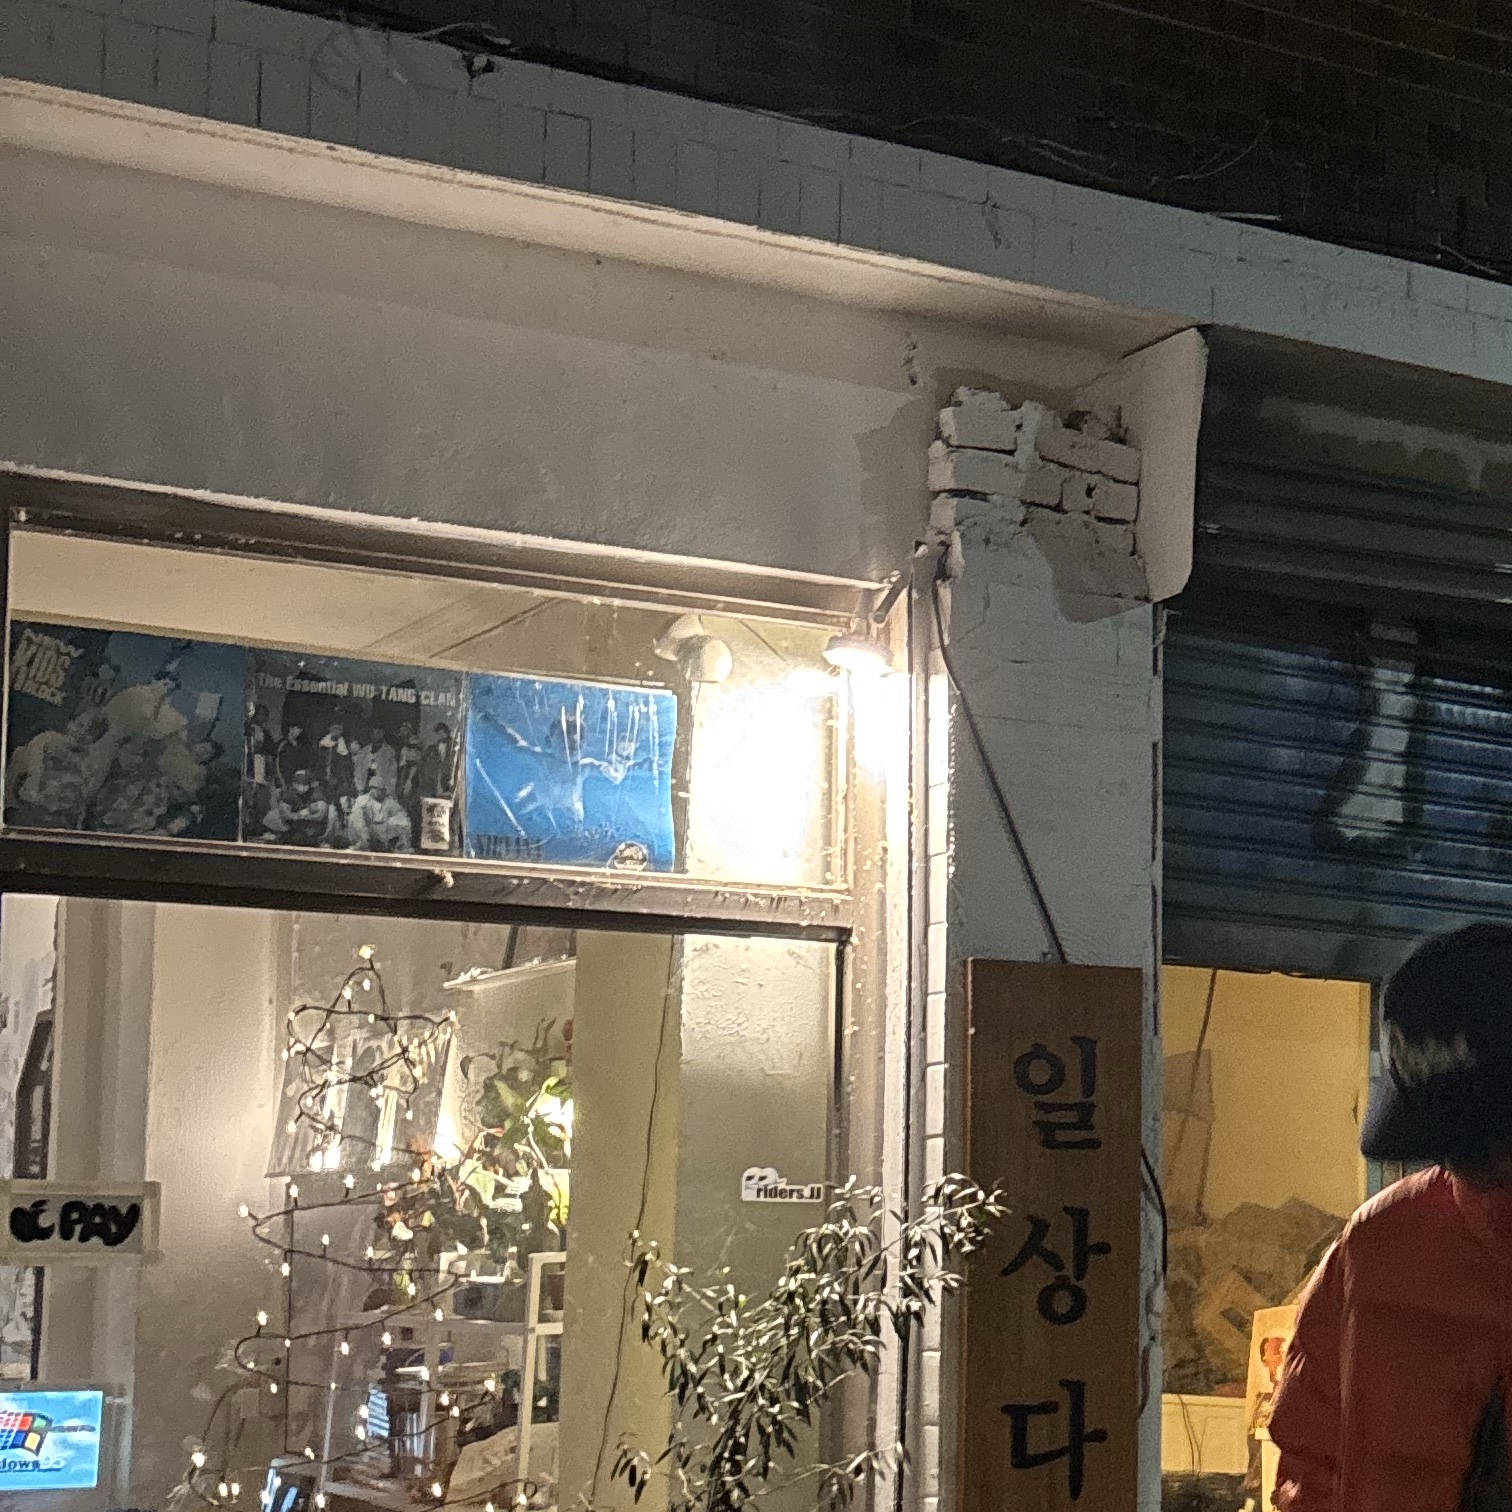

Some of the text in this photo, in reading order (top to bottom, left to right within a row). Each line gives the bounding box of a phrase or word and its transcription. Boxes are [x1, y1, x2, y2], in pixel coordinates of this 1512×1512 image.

[257, 672, 456, 708] The Essential WU-TANG CLAN
[59, 1200, 141, 1246] PAY
